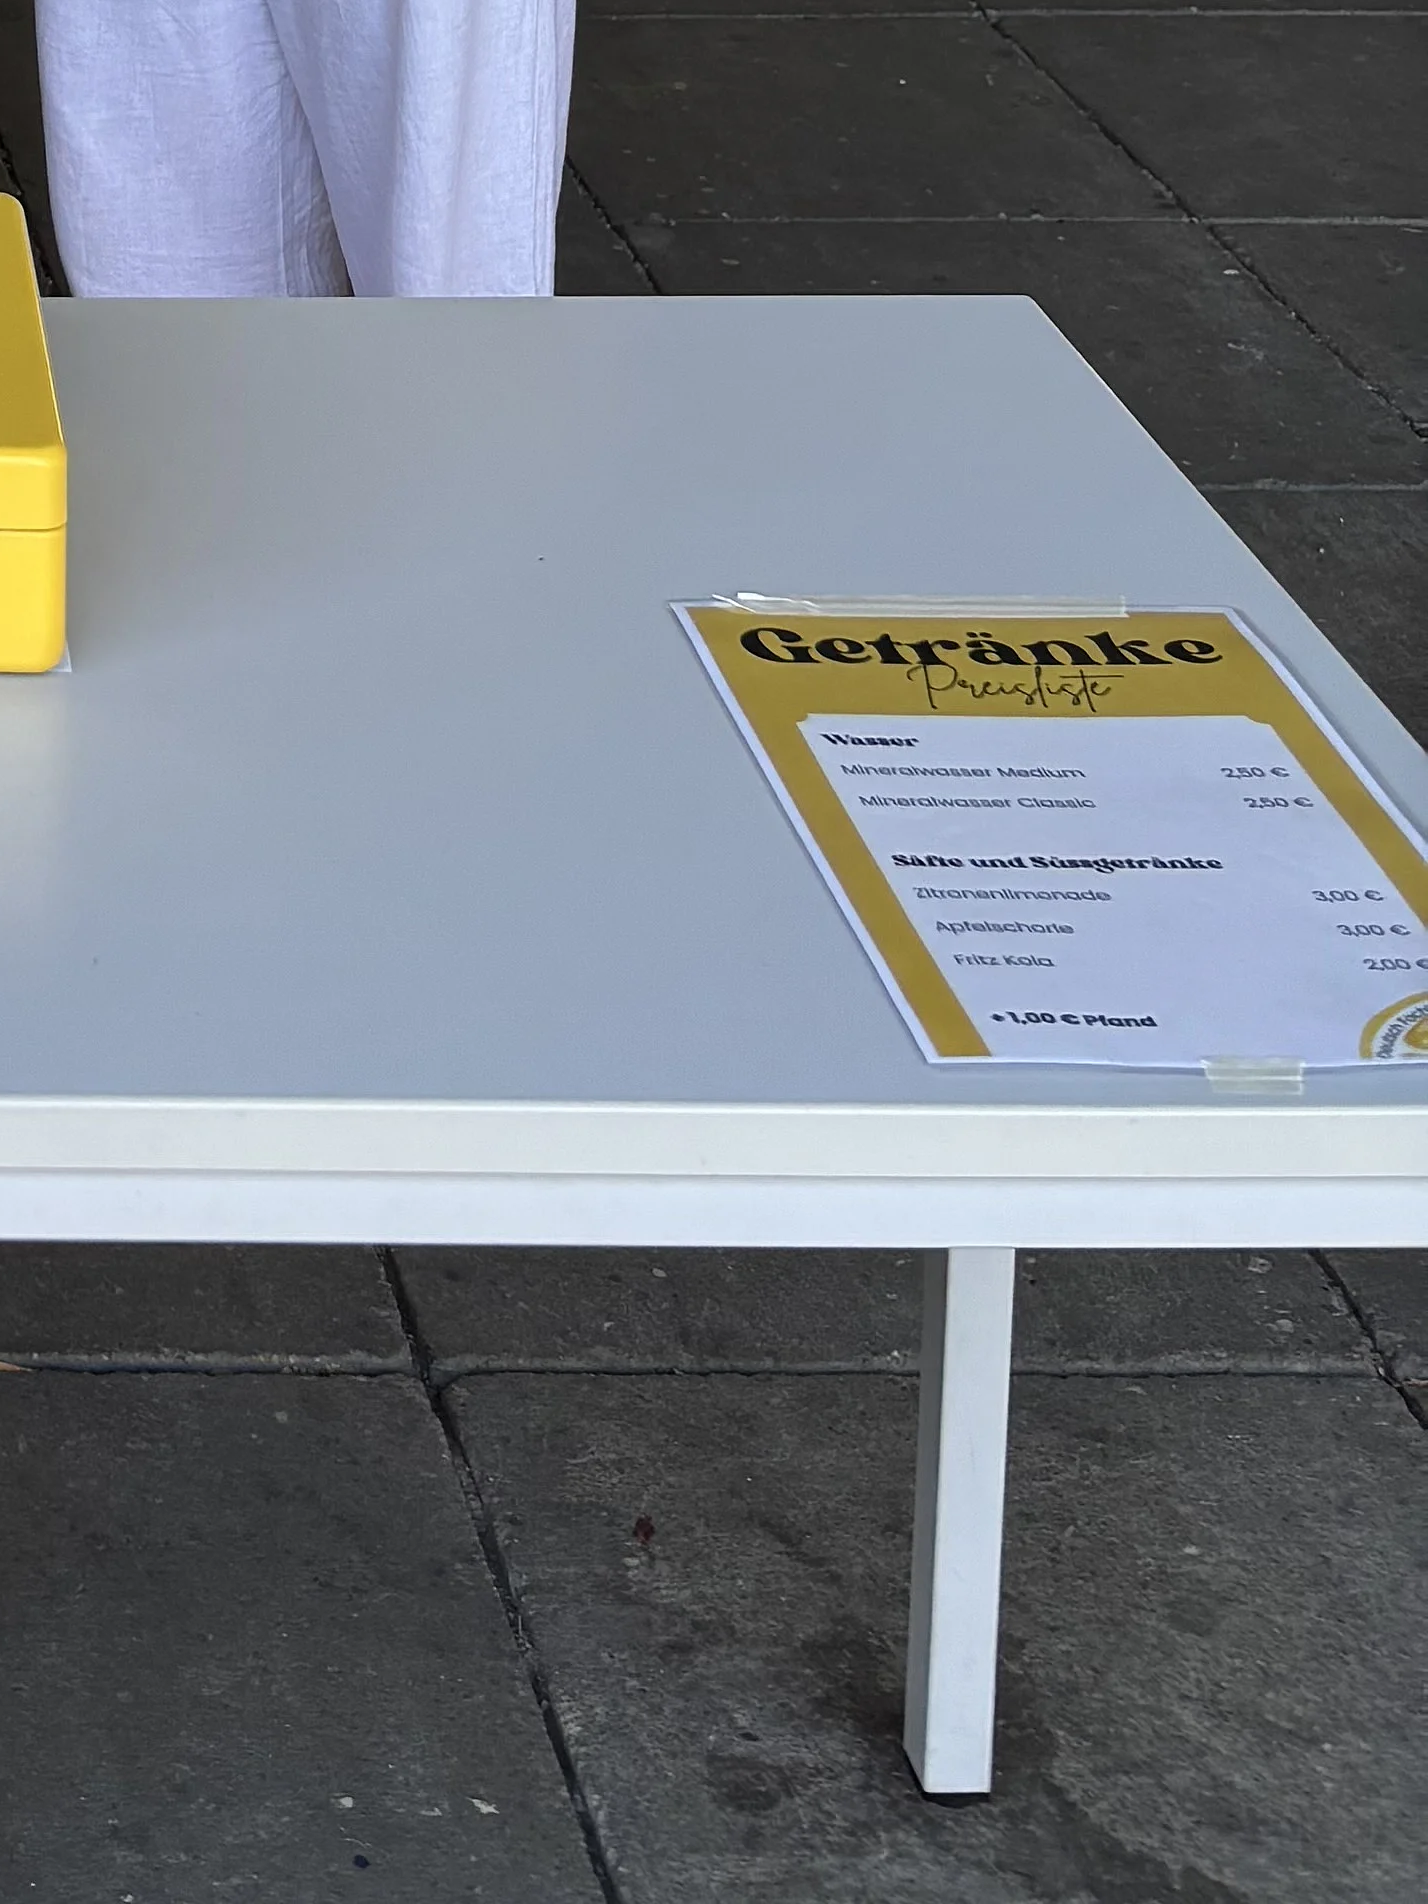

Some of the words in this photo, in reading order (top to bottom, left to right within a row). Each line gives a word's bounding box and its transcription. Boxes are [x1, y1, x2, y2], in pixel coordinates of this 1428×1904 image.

[740, 627, 1224, 666] Getränke
[907, 663, 1125, 712] Preisliste
[820, 733, 919, 748] Wasser
[840, 763, 993, 778] Mineralwasser
[996, 767, 1087, 779] Medium
[1270, 767, 1291, 778] €
[859, 794, 1012, 809] Mineralwasser
[1017, 796, 1097, 809] Classic
[1294, 796, 1314, 808] €
[968, 856, 1028, 869] und
[913, 886, 1112, 902] Zitronenlimonade
[1312, 890, 1360, 903] 3,00
[1365, 890, 1385, 902] €
[936, 920, 1075, 936] Apfelschorle
[1337, 924, 1386, 937] 3,00
[1389, 924, 1411, 936] €
[954, 953, 1001, 967] Fritz
[1004, 954, 1056, 968] Kola
[1060, 1013, 1081, 1026] €
[1084, 1014, 1158, 1029] Pfand
